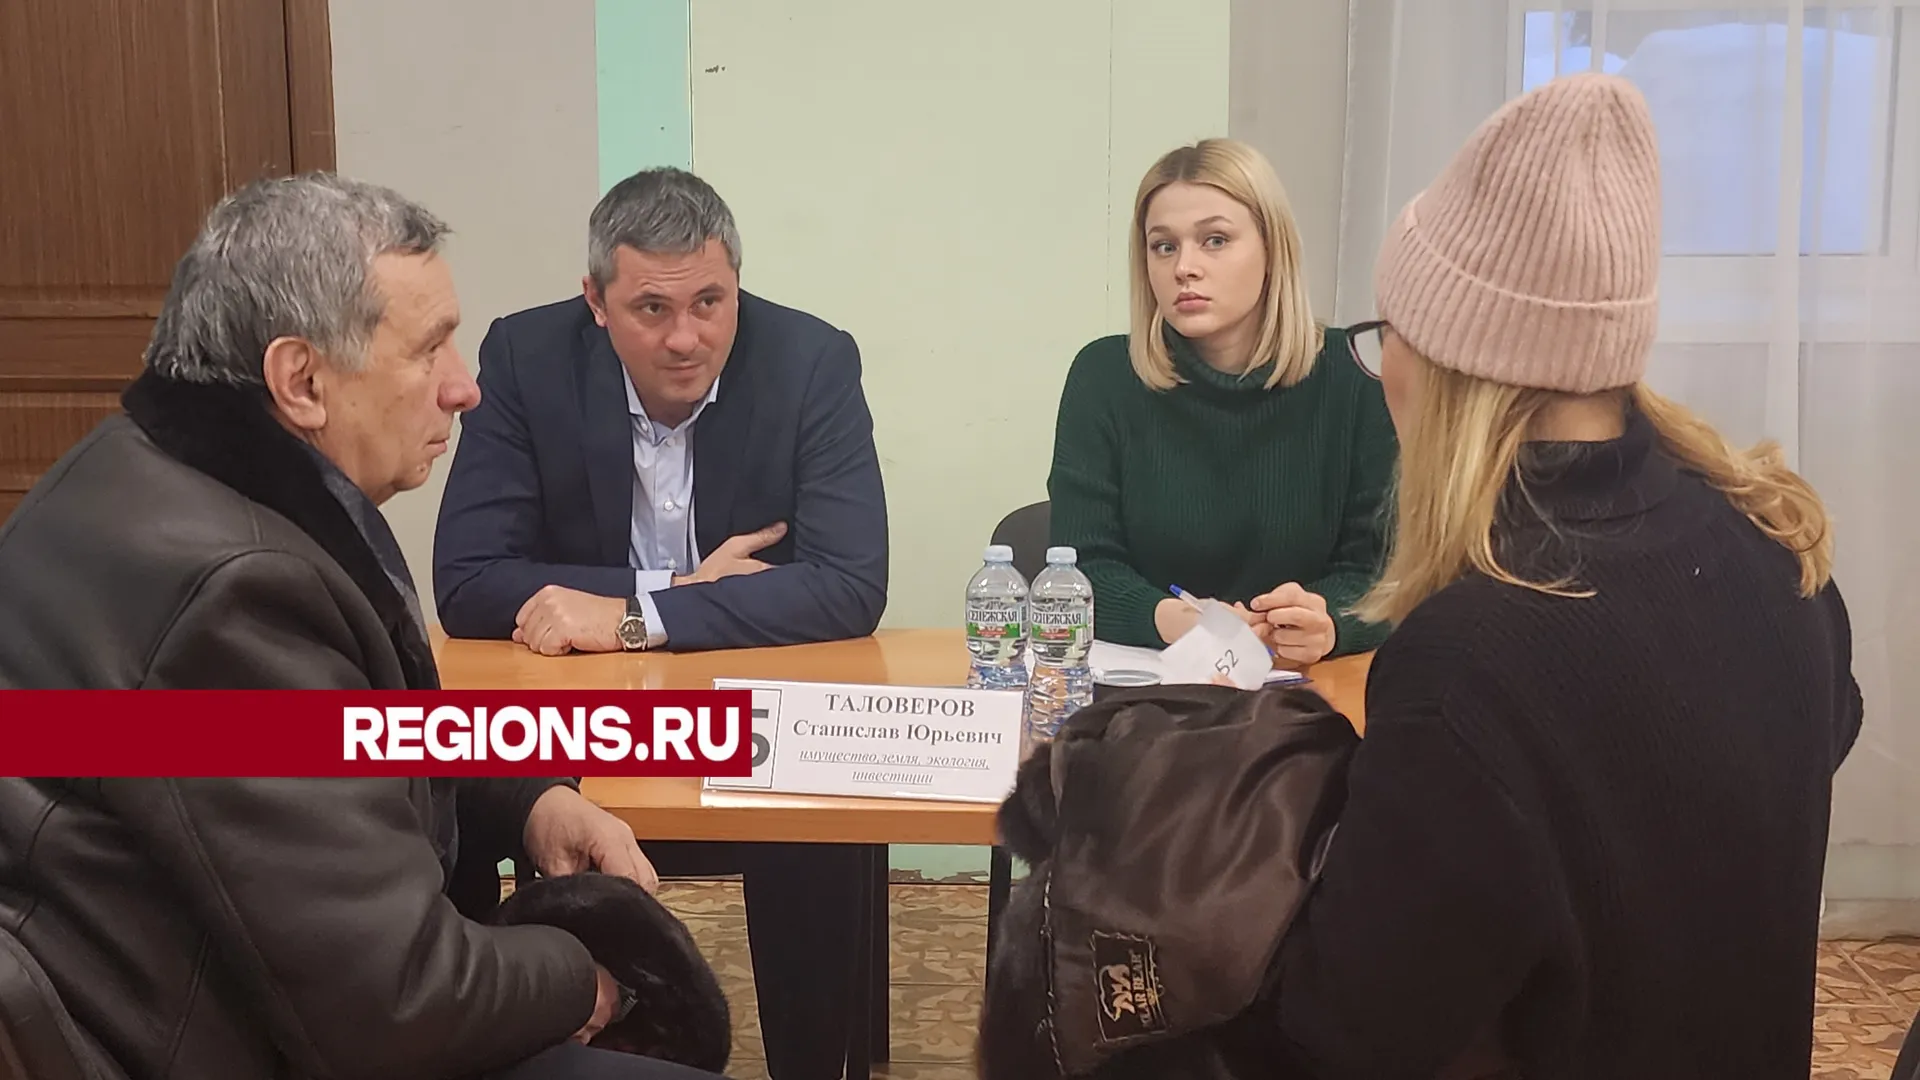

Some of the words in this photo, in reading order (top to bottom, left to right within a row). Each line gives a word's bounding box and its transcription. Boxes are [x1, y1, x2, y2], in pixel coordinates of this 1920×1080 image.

[968, 609, 1018, 622] СЕНЕЖСКАЯ
[1032, 612, 1082, 625] СЕНЕЖСКАЯ
[1215, 649, 1239, 676] 52
[825, 693, 975, 717] ТАЛОВЕРОВ
[793, 719, 900, 740] Станислав
[907, 724, 1003, 745] Юрьевич
[926, 757, 990, 770] экология,
[852, 770, 933, 784] инвестиции
